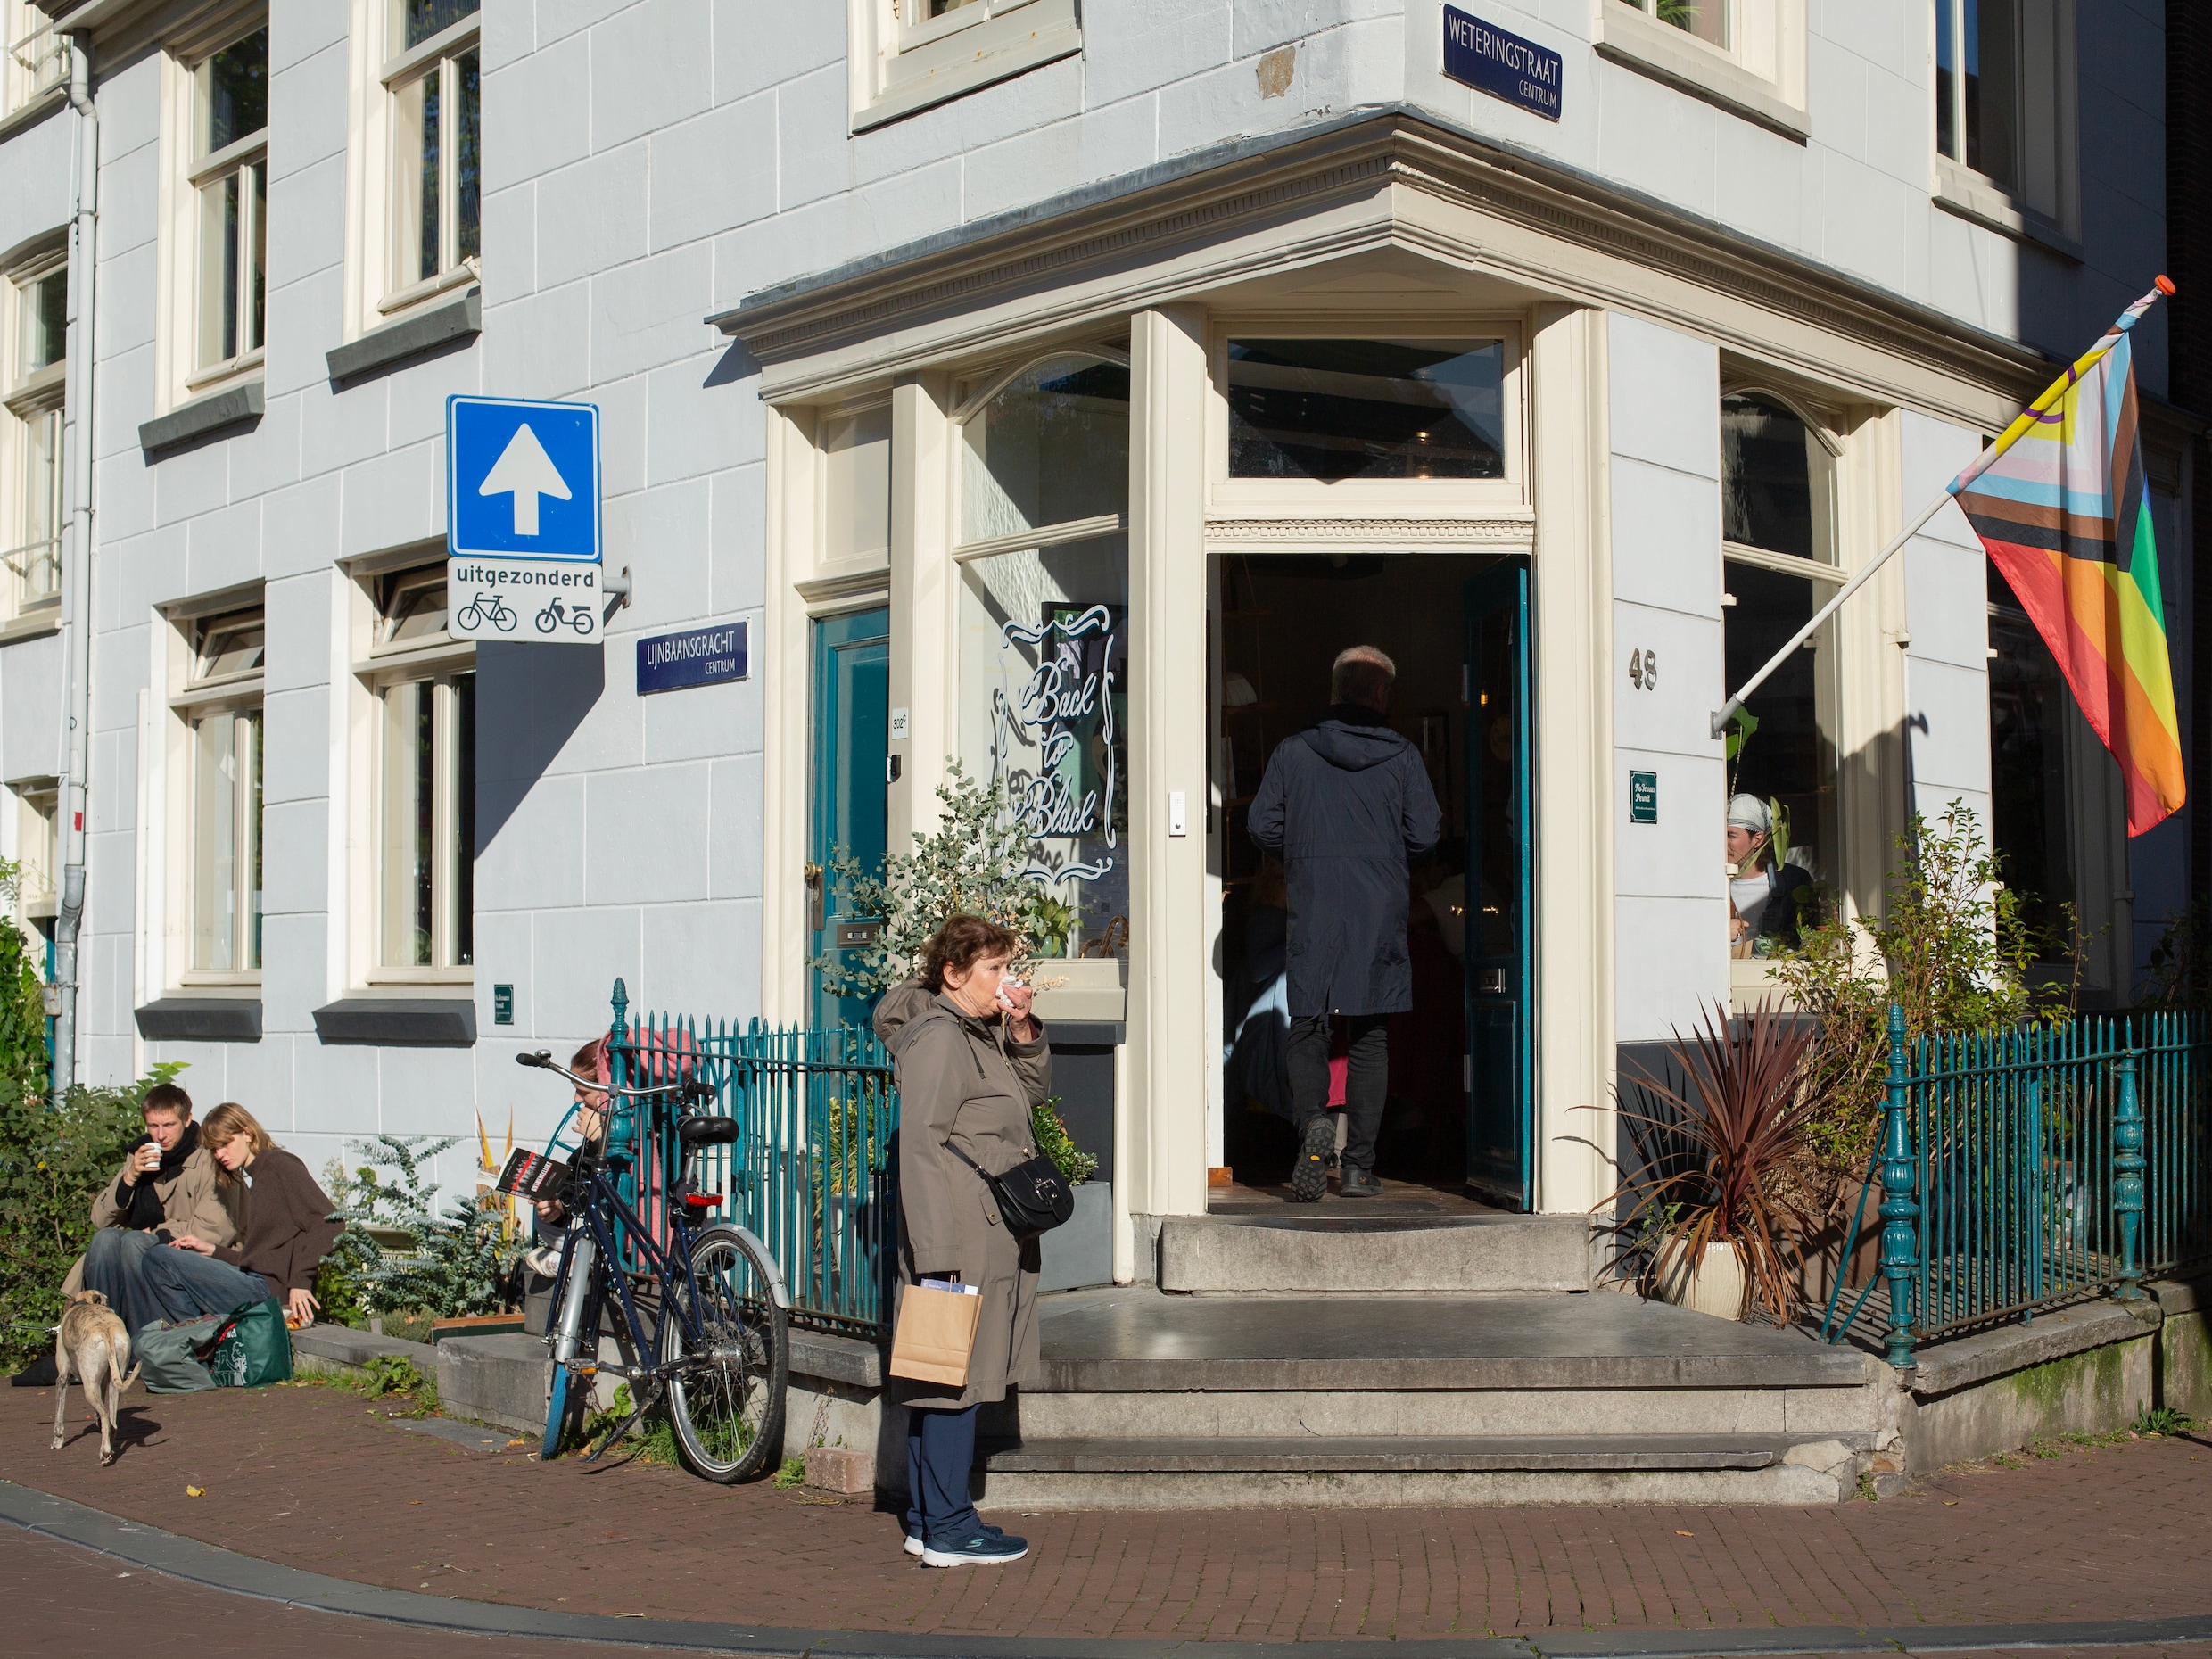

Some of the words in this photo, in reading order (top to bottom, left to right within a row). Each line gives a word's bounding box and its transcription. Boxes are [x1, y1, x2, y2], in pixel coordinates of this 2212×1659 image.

[1449, 14, 1558, 87] WETERINGSTRAAT
[1518, 79, 1557, 109] CENTRUM
[457, 565, 594, 589] uitgezonderd
[647, 630, 735, 670] LIJNBAANSGRACHT
[704, 657, 736, 675] CENTRUM
[1629, 648, 1657, 691] 48
[1018, 656, 1098, 726] Back
[1039, 722, 1074, 769] to
[1013, 770, 1098, 839] Black
